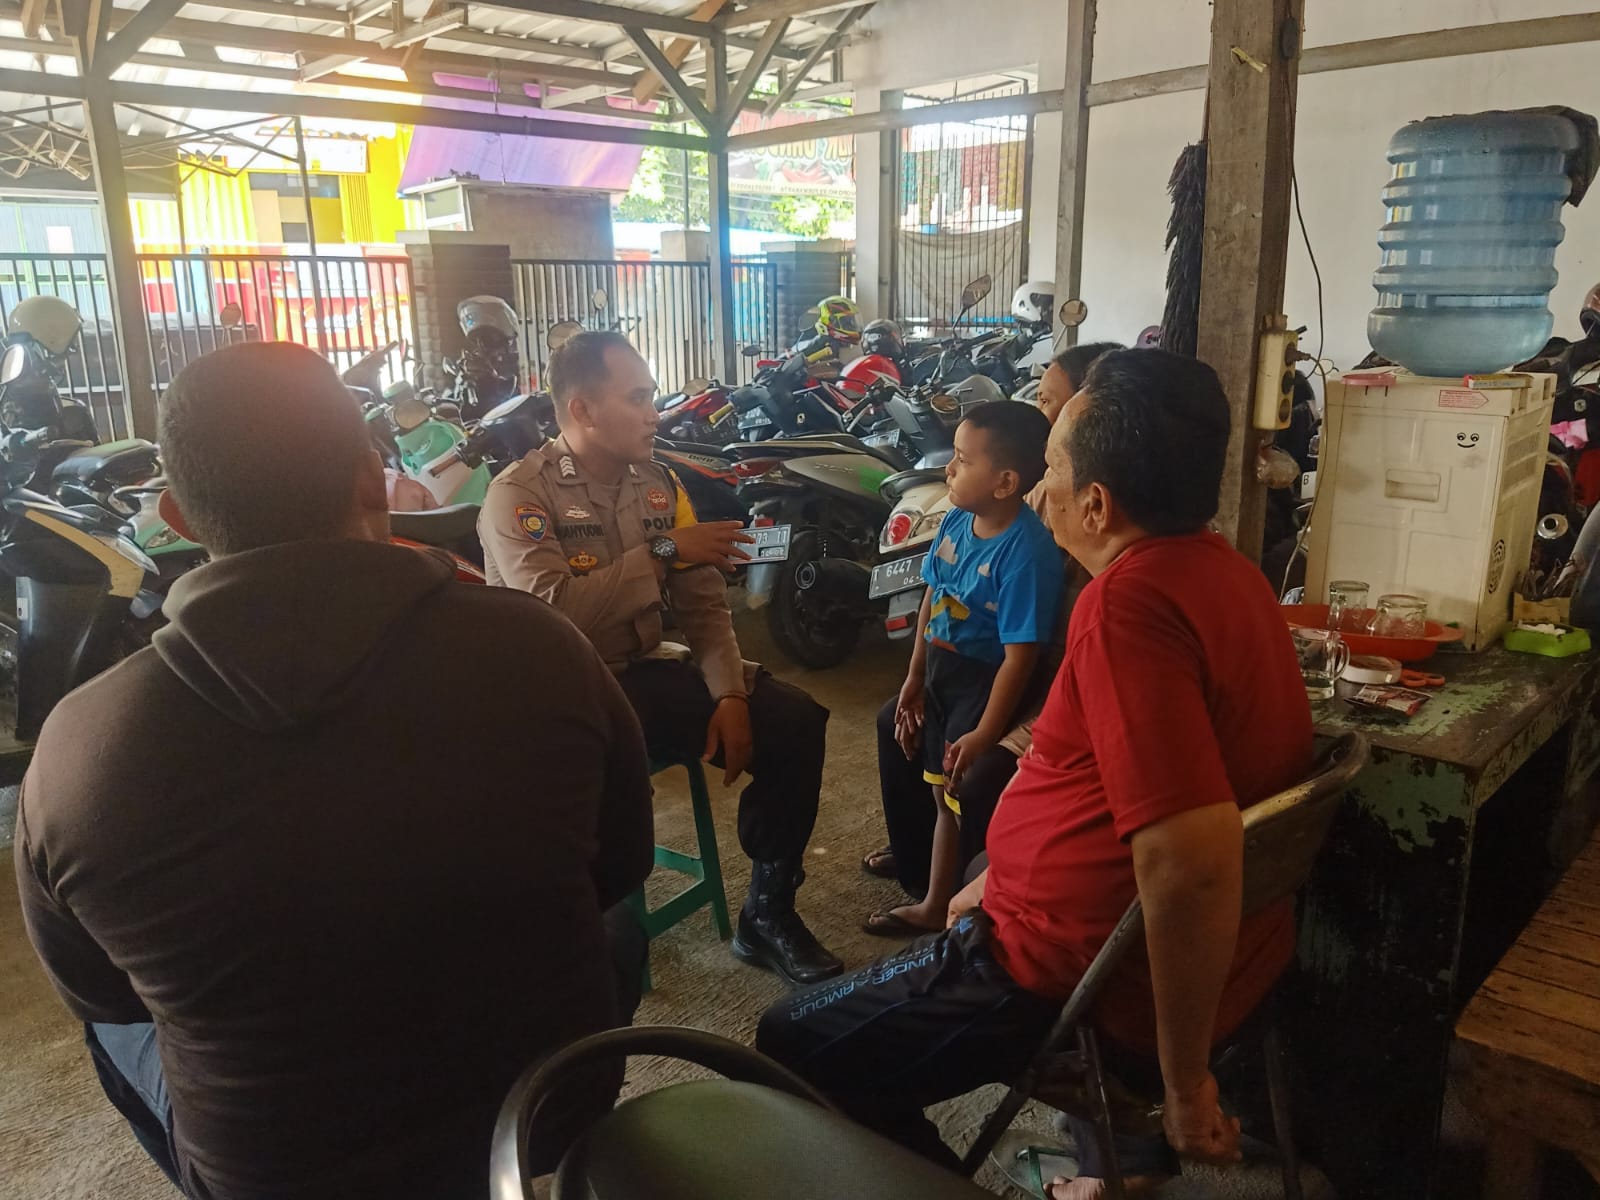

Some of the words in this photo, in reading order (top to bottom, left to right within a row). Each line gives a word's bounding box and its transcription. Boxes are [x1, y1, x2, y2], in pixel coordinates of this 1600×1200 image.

[886, 559, 913, 577] 6447
[872, 951, 935, 985] UNDER
[790, 978, 870, 1020] ARMOUR
